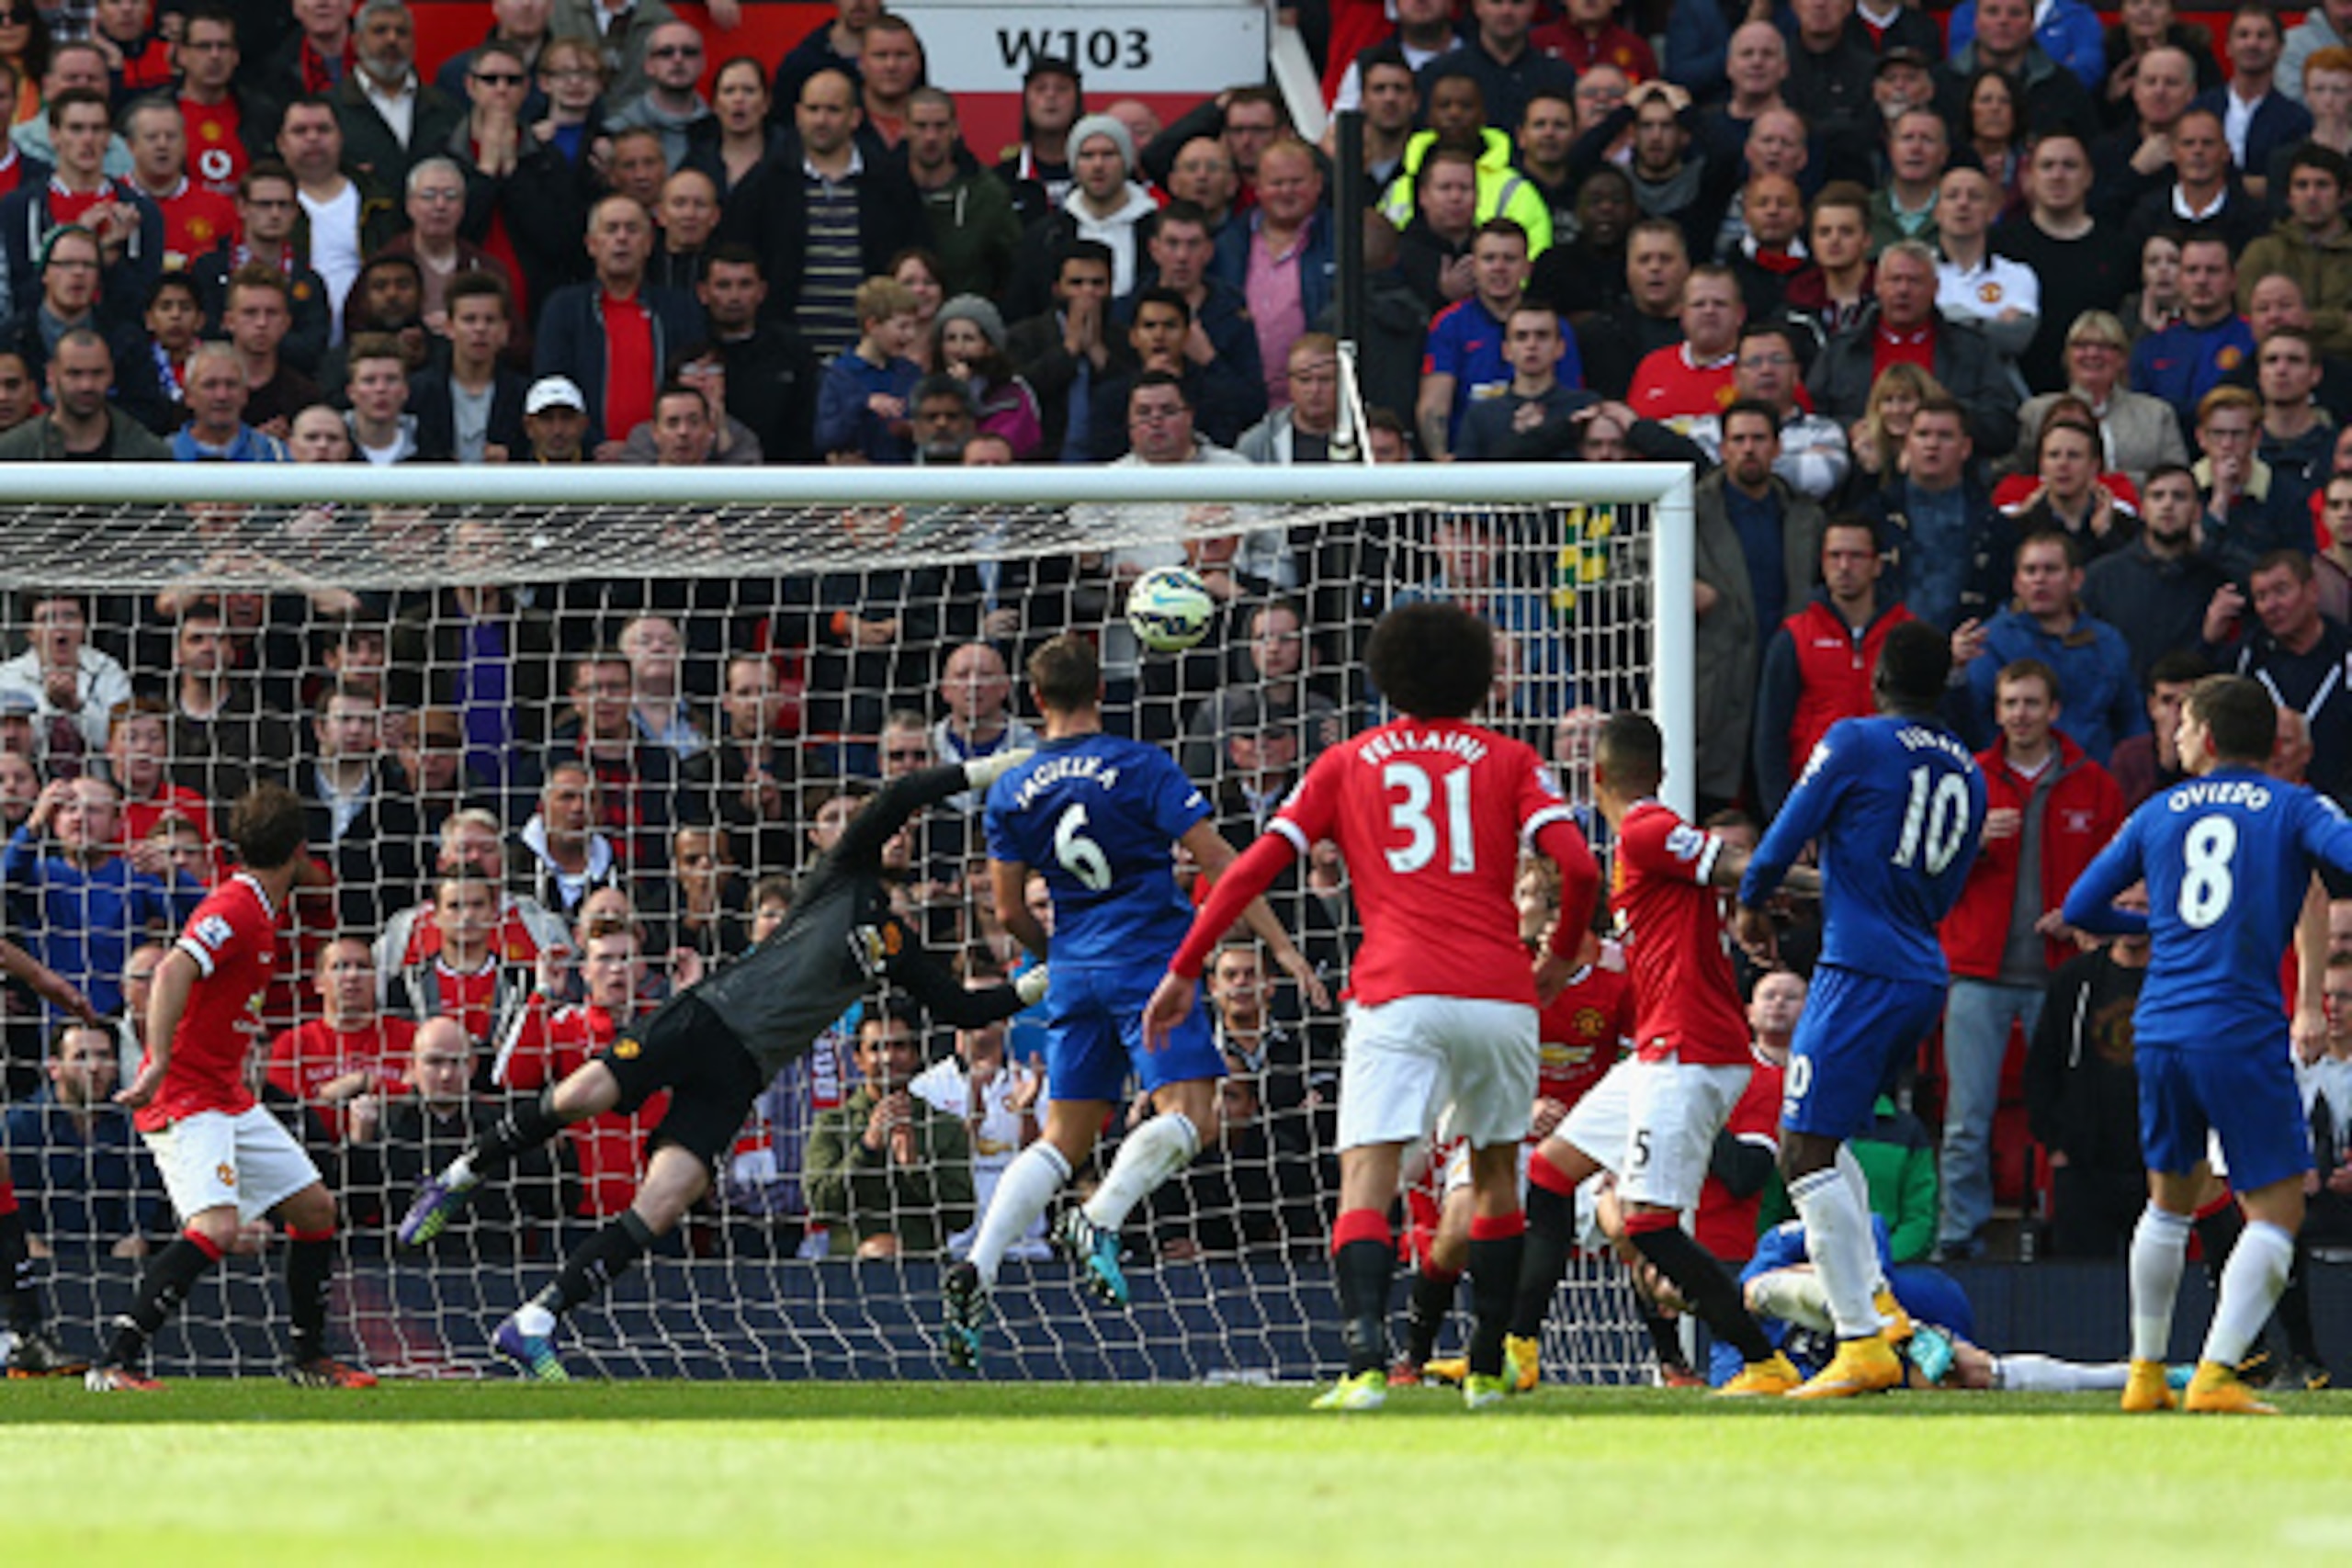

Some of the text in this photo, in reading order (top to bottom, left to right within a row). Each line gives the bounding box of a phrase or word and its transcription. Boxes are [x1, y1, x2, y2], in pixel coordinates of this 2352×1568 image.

[997, 29, 1151, 70] W103
[1358, 730, 1488, 765] FELLAINI
[1384, 762, 1476, 873] 31
[1891, 764, 1969, 874] 10
[2168, 782, 2271, 812] OVIEDO
[1055, 803, 1112, 890] 6
[2177, 814, 2237, 930] 8
[1634, 1129, 1651, 1168] 5
